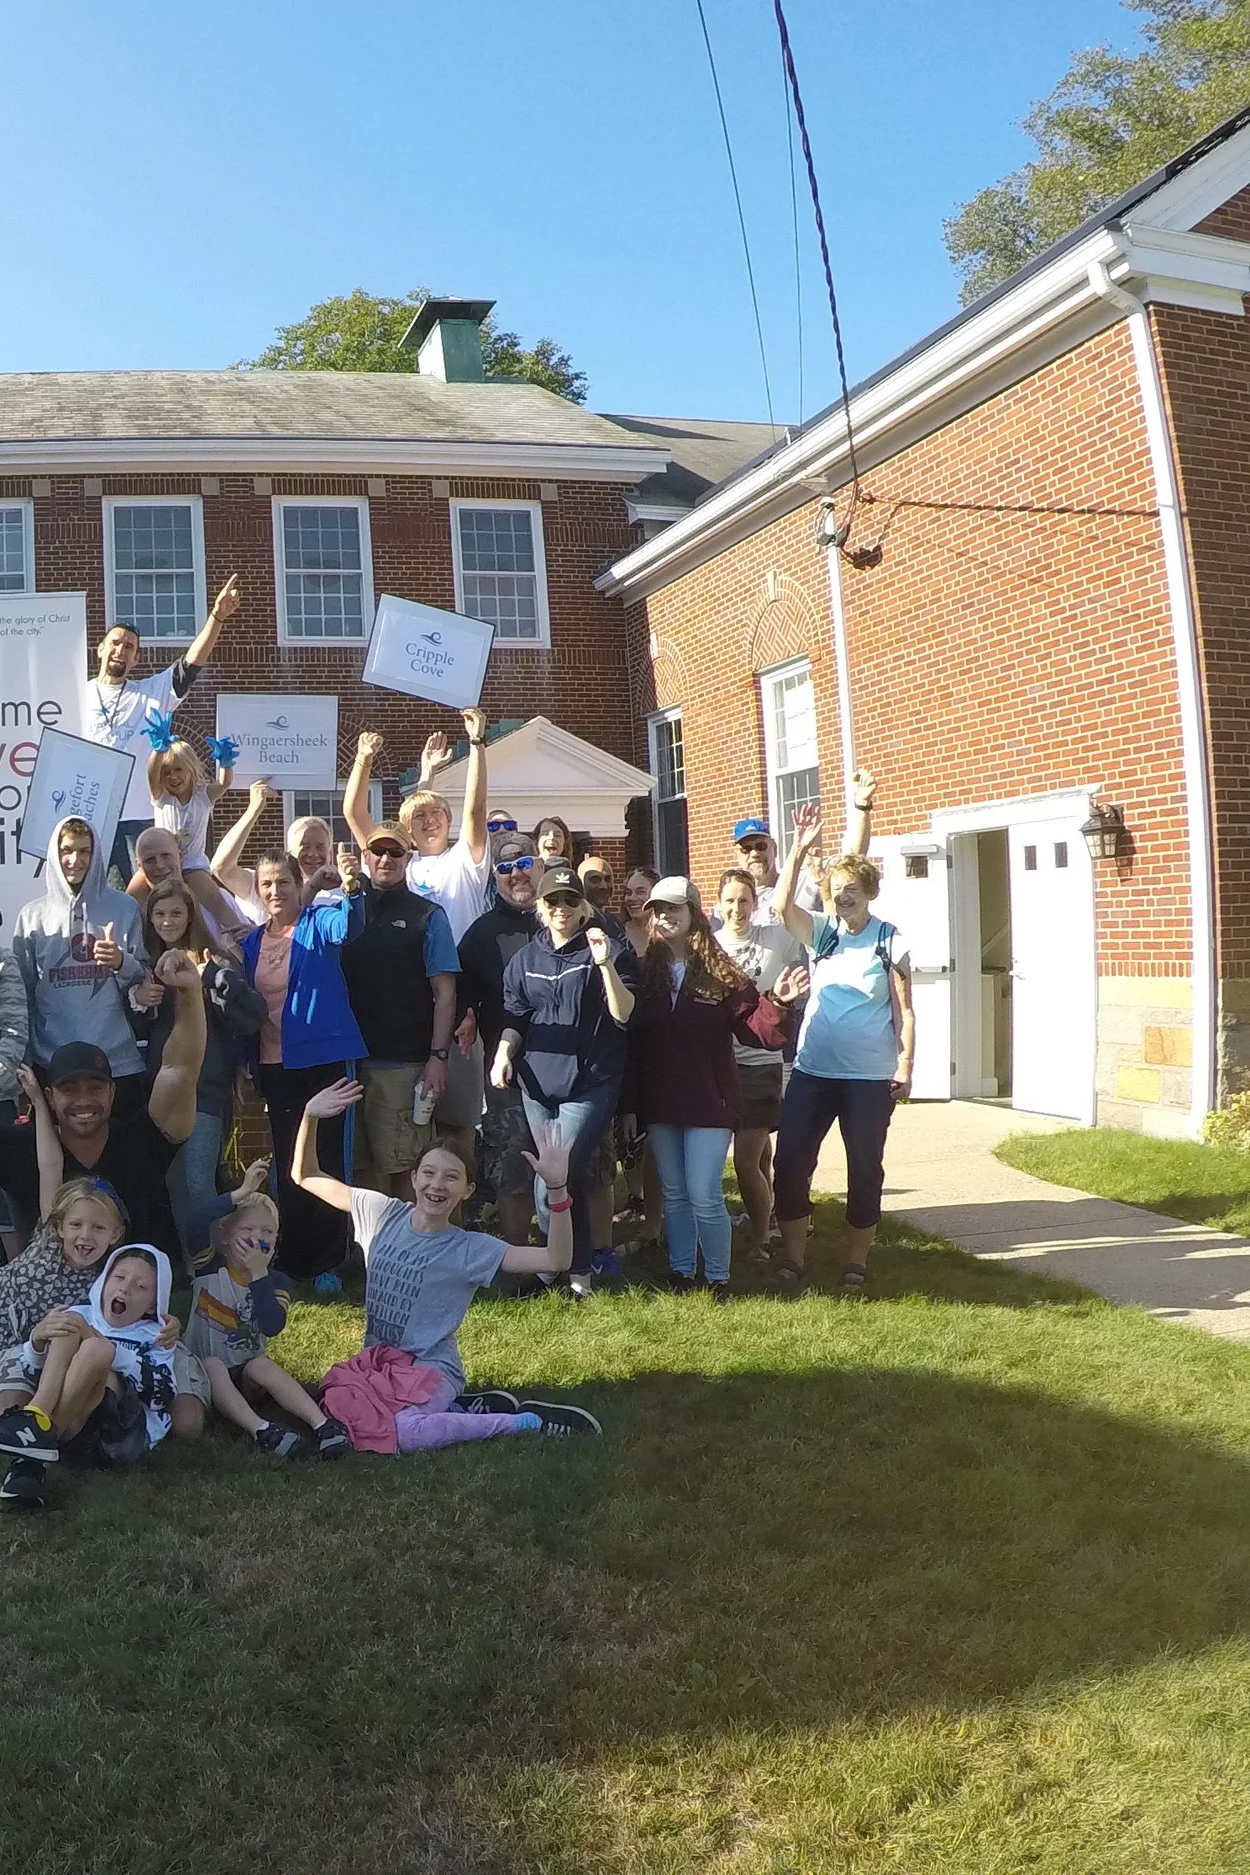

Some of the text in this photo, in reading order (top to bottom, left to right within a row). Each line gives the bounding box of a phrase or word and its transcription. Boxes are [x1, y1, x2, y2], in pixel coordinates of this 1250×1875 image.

[0, 616, 12, 625] the
[15, 615, 35, 625] glory
[38, 614, 46, 623] of
[48, 613, 70, 623] Christ
[0, 627, 9, 636] of
[11, 627, 23, 636] the
[405, 642, 455, 665] Cripple
[410, 658, 444, 678] Cove
[230, 733, 328, 750] Wingaersheek
[258, 750, 299, 763] Beach
[16, 1426, 37, 1447] N
